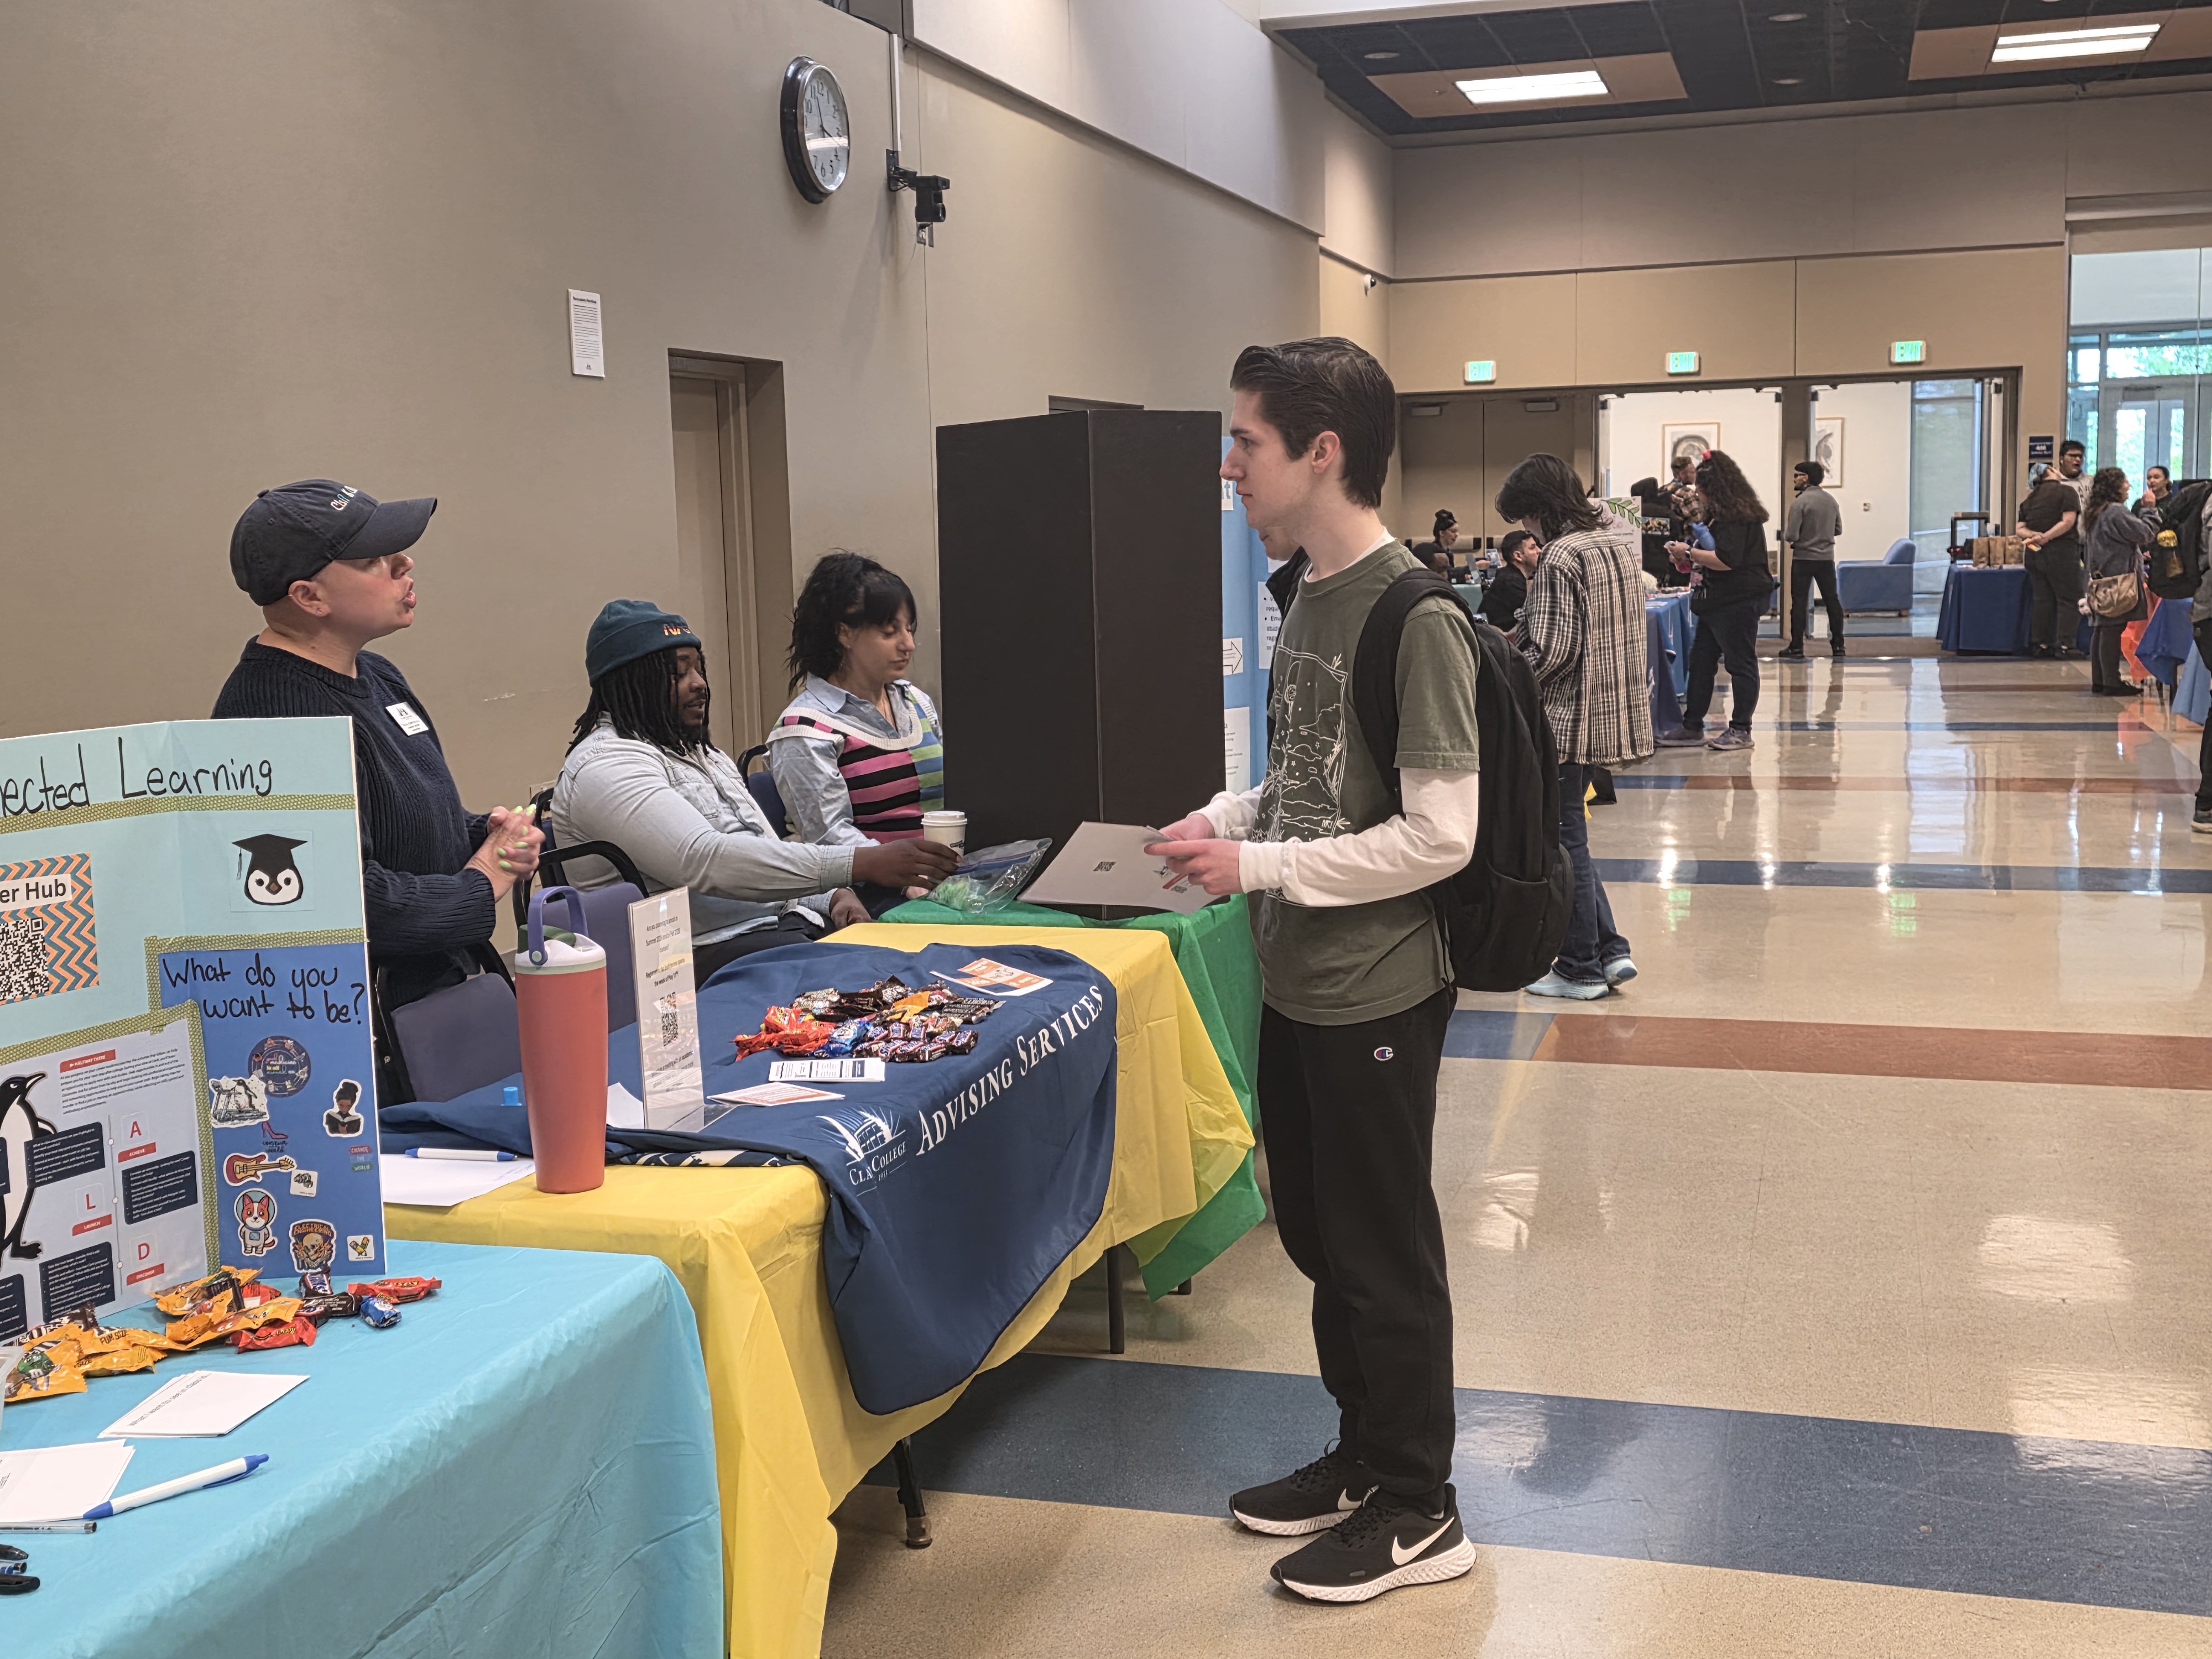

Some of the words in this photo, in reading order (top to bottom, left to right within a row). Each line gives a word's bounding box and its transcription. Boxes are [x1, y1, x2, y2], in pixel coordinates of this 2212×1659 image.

[1896, 342, 1922, 362] EXIT
[118, 737, 272, 798] Learning
[25, 878, 66, 901] Hub
[162, 959, 230, 988] What
[245, 953, 275, 987] do
[291, 967, 337, 997] you
[203, 994, 274, 1018] want
[286, 993, 315, 1020] to
[324, 983, 365, 1025] be?
[74, 1058, 93, 1066] HALFWAY
[916, 1058, 1013, 1156] ADVISING
[1016, 985, 1104, 1077] SERVICES
[129, 1120, 142, 1139] A
[129, 1148, 145, 1157] ACHIEVE
[849, 1166, 874, 1186] CLA
[871, 1141, 906, 1172] COLLEGE
[85, 1193, 96, 1210] L
[138, 1243, 150, 1260] D
[100, 1333, 113, 1345] FUN
[114, 1329, 129, 1340] SIZE
[186, 1378, 202, 1389] class
